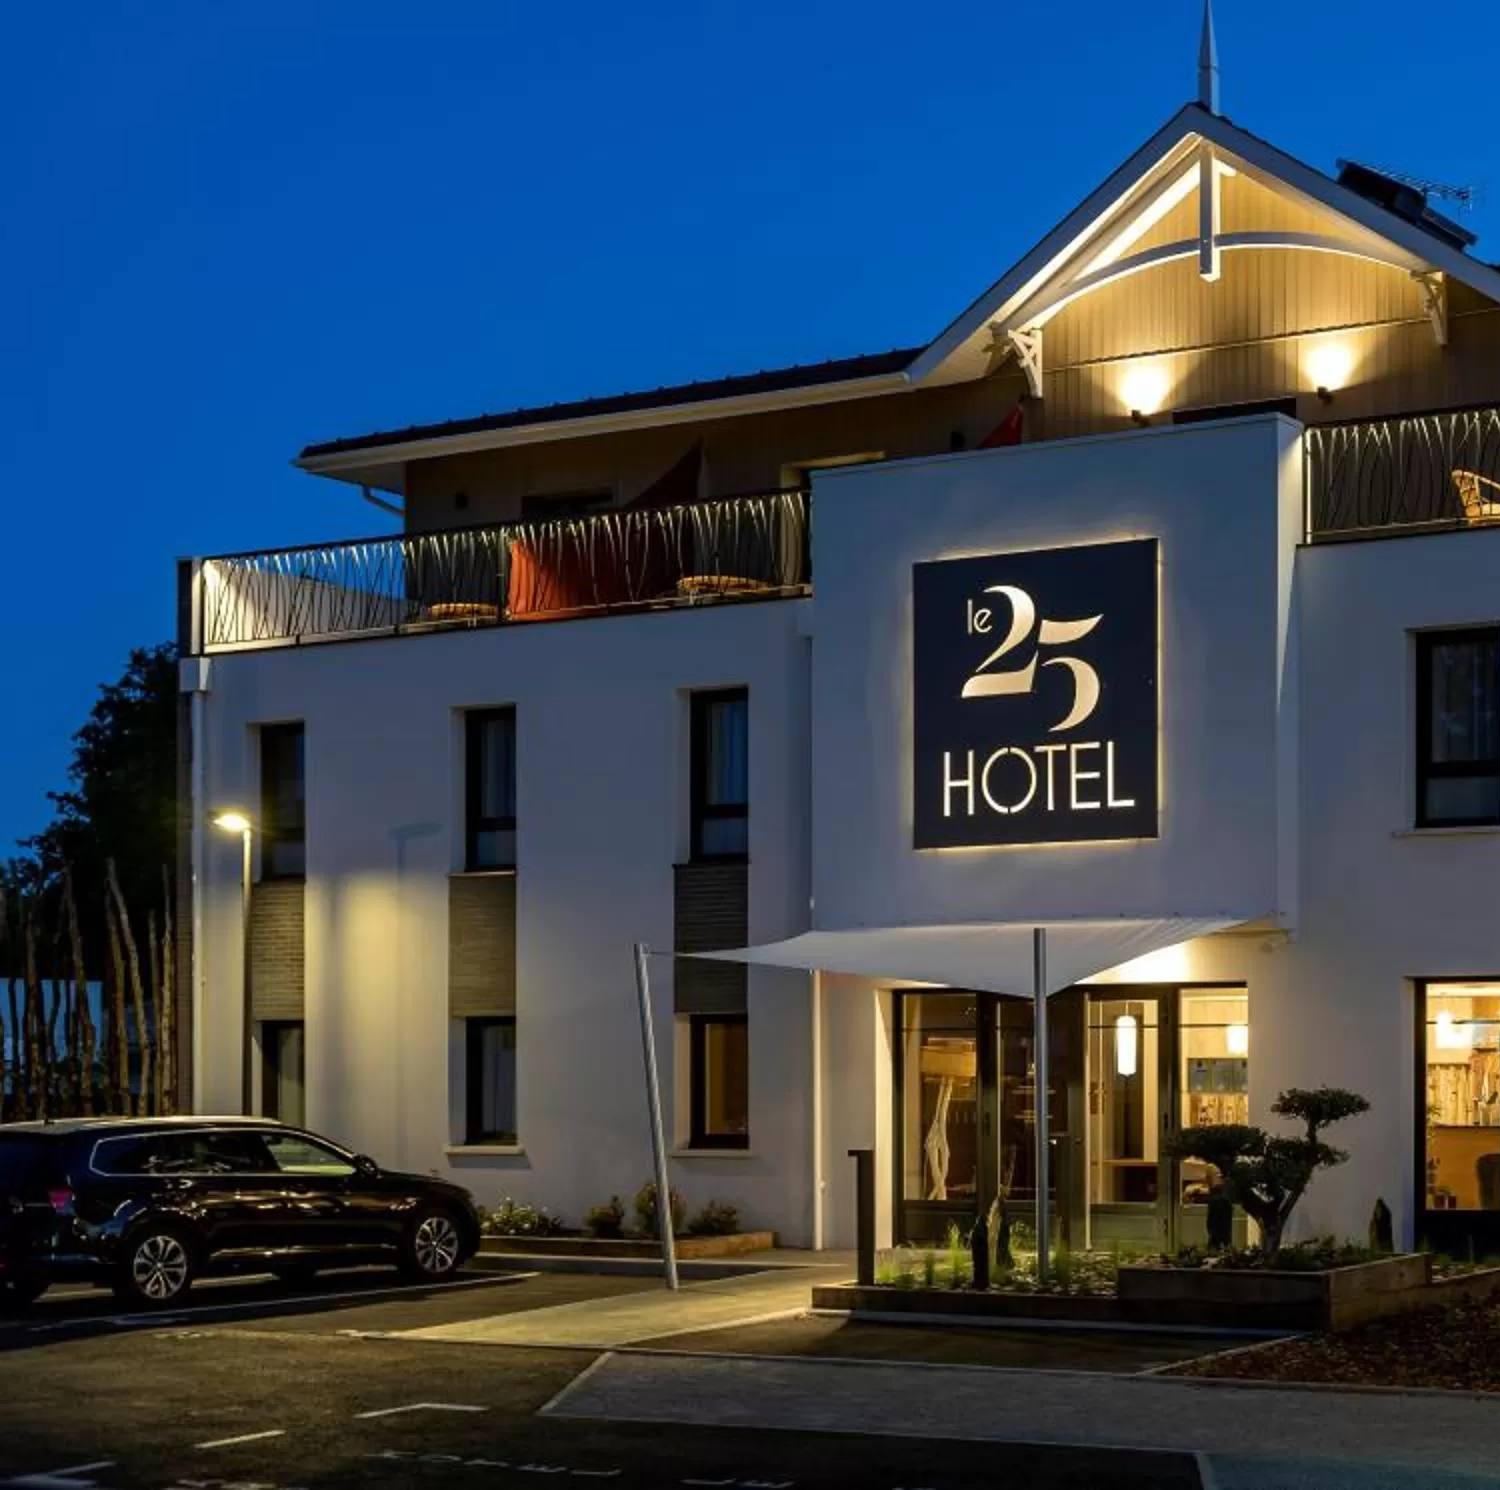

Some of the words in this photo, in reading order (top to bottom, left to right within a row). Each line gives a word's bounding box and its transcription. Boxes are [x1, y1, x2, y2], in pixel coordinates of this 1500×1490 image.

[967, 599, 993, 634] le
[961, 585, 1104, 732] 25
[943, 741, 1135, 817] HOTEL
